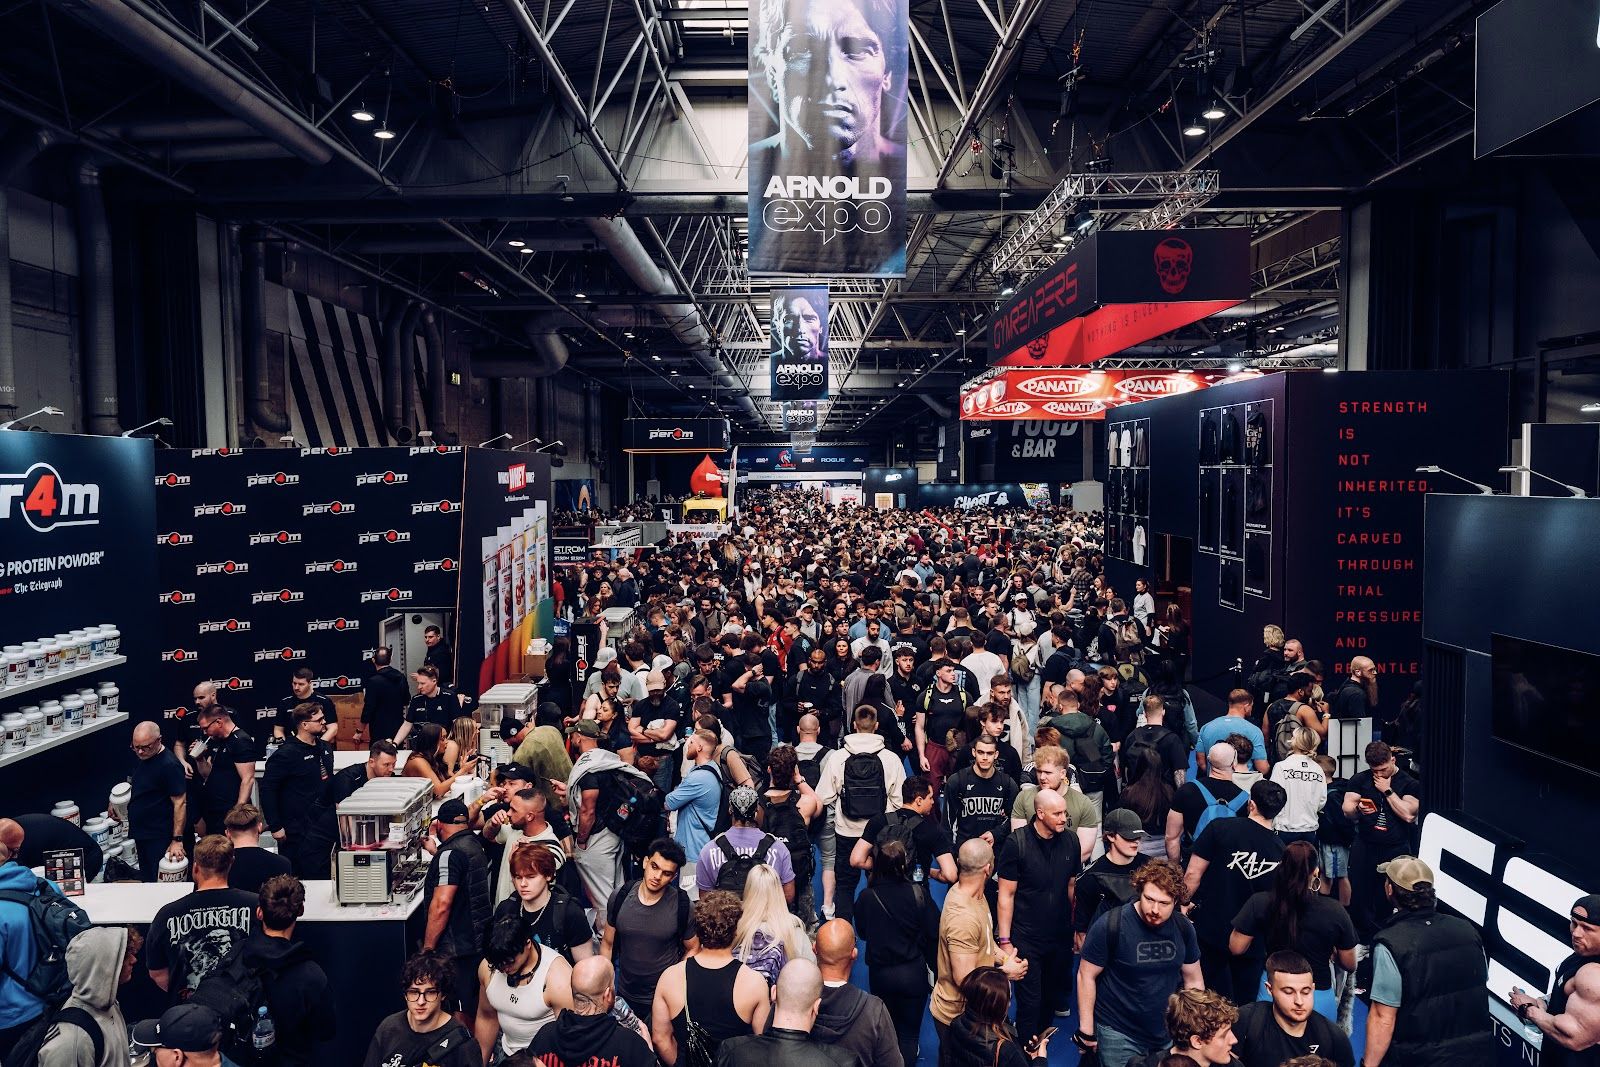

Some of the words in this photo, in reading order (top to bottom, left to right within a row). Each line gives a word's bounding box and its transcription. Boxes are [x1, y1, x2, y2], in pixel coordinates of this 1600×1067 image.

[763, 176, 892, 199] ARNOLD
[763, 199, 892, 245] expo
[994, 262, 1077, 350] GYMREAPERS
[776, 364, 823, 374] ARNOLD
[775, 373, 823, 391] expo
[1029, 380, 1095, 392] PANATTA
[988, 402, 1025, 412] NATTA
[1051, 402, 1100, 413] PANATTA
[1339, 402, 1427, 413] STRENGTH
[786, 416, 814, 425] expo
[1012, 420, 1079, 436] FOOD
[649, 428, 693, 440] per4m
[1339, 428, 1354, 440] IS
[1012, 444, 1021, 457] &
[1022, 438, 1056, 457] BAR
[1338, 454, 1370, 466] NOT
[247, 472, 299, 487] per4m
[356, 471, 408, 486] per4m
[1338, 481, 1433, 492] INHERITED.
[194, 502, 246, 517] per4m
[302, 501, 355, 516] per4m
[1338, 507, 1370, 518] IT'S
[249, 531, 301, 545] per4m
[1337, 533, 1402, 544] CARVED
[7, 557, 56, 577] PROTEIN
[58, 551, 104, 570] POWDER"
[196, 560, 248, 575] per4m
[305, 559, 357, 574] per4m
[1337, 559, 1413, 570] THROUGH
[14, 583, 28, 594] The
[29, 577, 62, 592] Telegraph
[1338, 585, 1384, 596] TRIAL
[251, 589, 304, 604] per4m
[360, 588, 412, 603] per4m
[1336, 611, 1421, 622] PRESSURE
[199, 619, 251, 634] per4m
[307, 617, 359, 632] per4m
[1335, 637, 1367, 648] AND
[254, 647, 306, 662] per4m
[1284, 769, 1323, 782] Kappa
[1137, 940, 1176, 962] SBD
